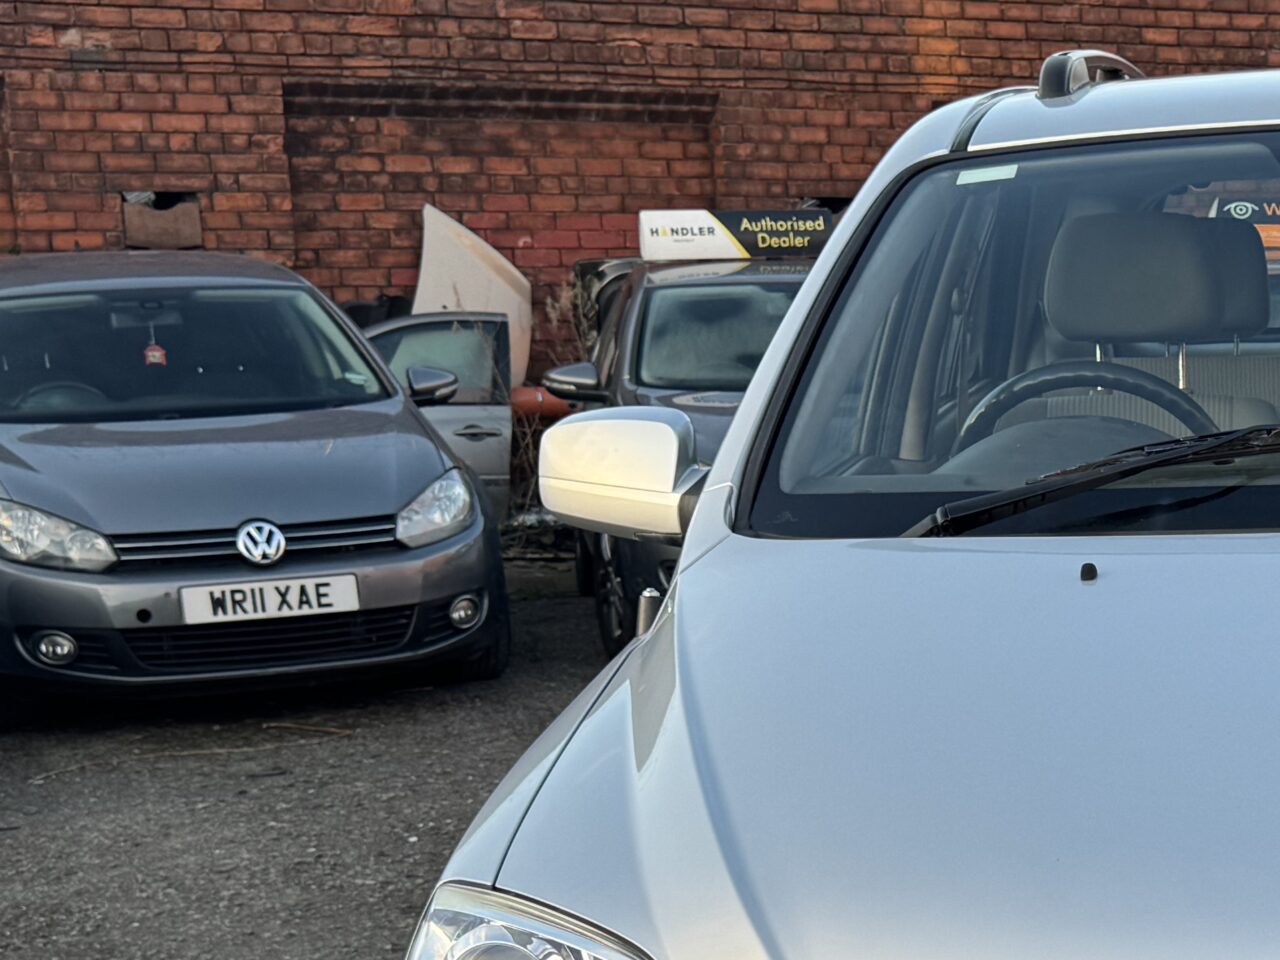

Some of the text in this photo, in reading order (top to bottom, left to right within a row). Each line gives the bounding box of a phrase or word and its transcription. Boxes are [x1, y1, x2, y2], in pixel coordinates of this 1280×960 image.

[739, 216, 825, 232] Authorised
[757, 233, 811, 248] Dealer
[209, 582, 334, 617] WR11 XAE
